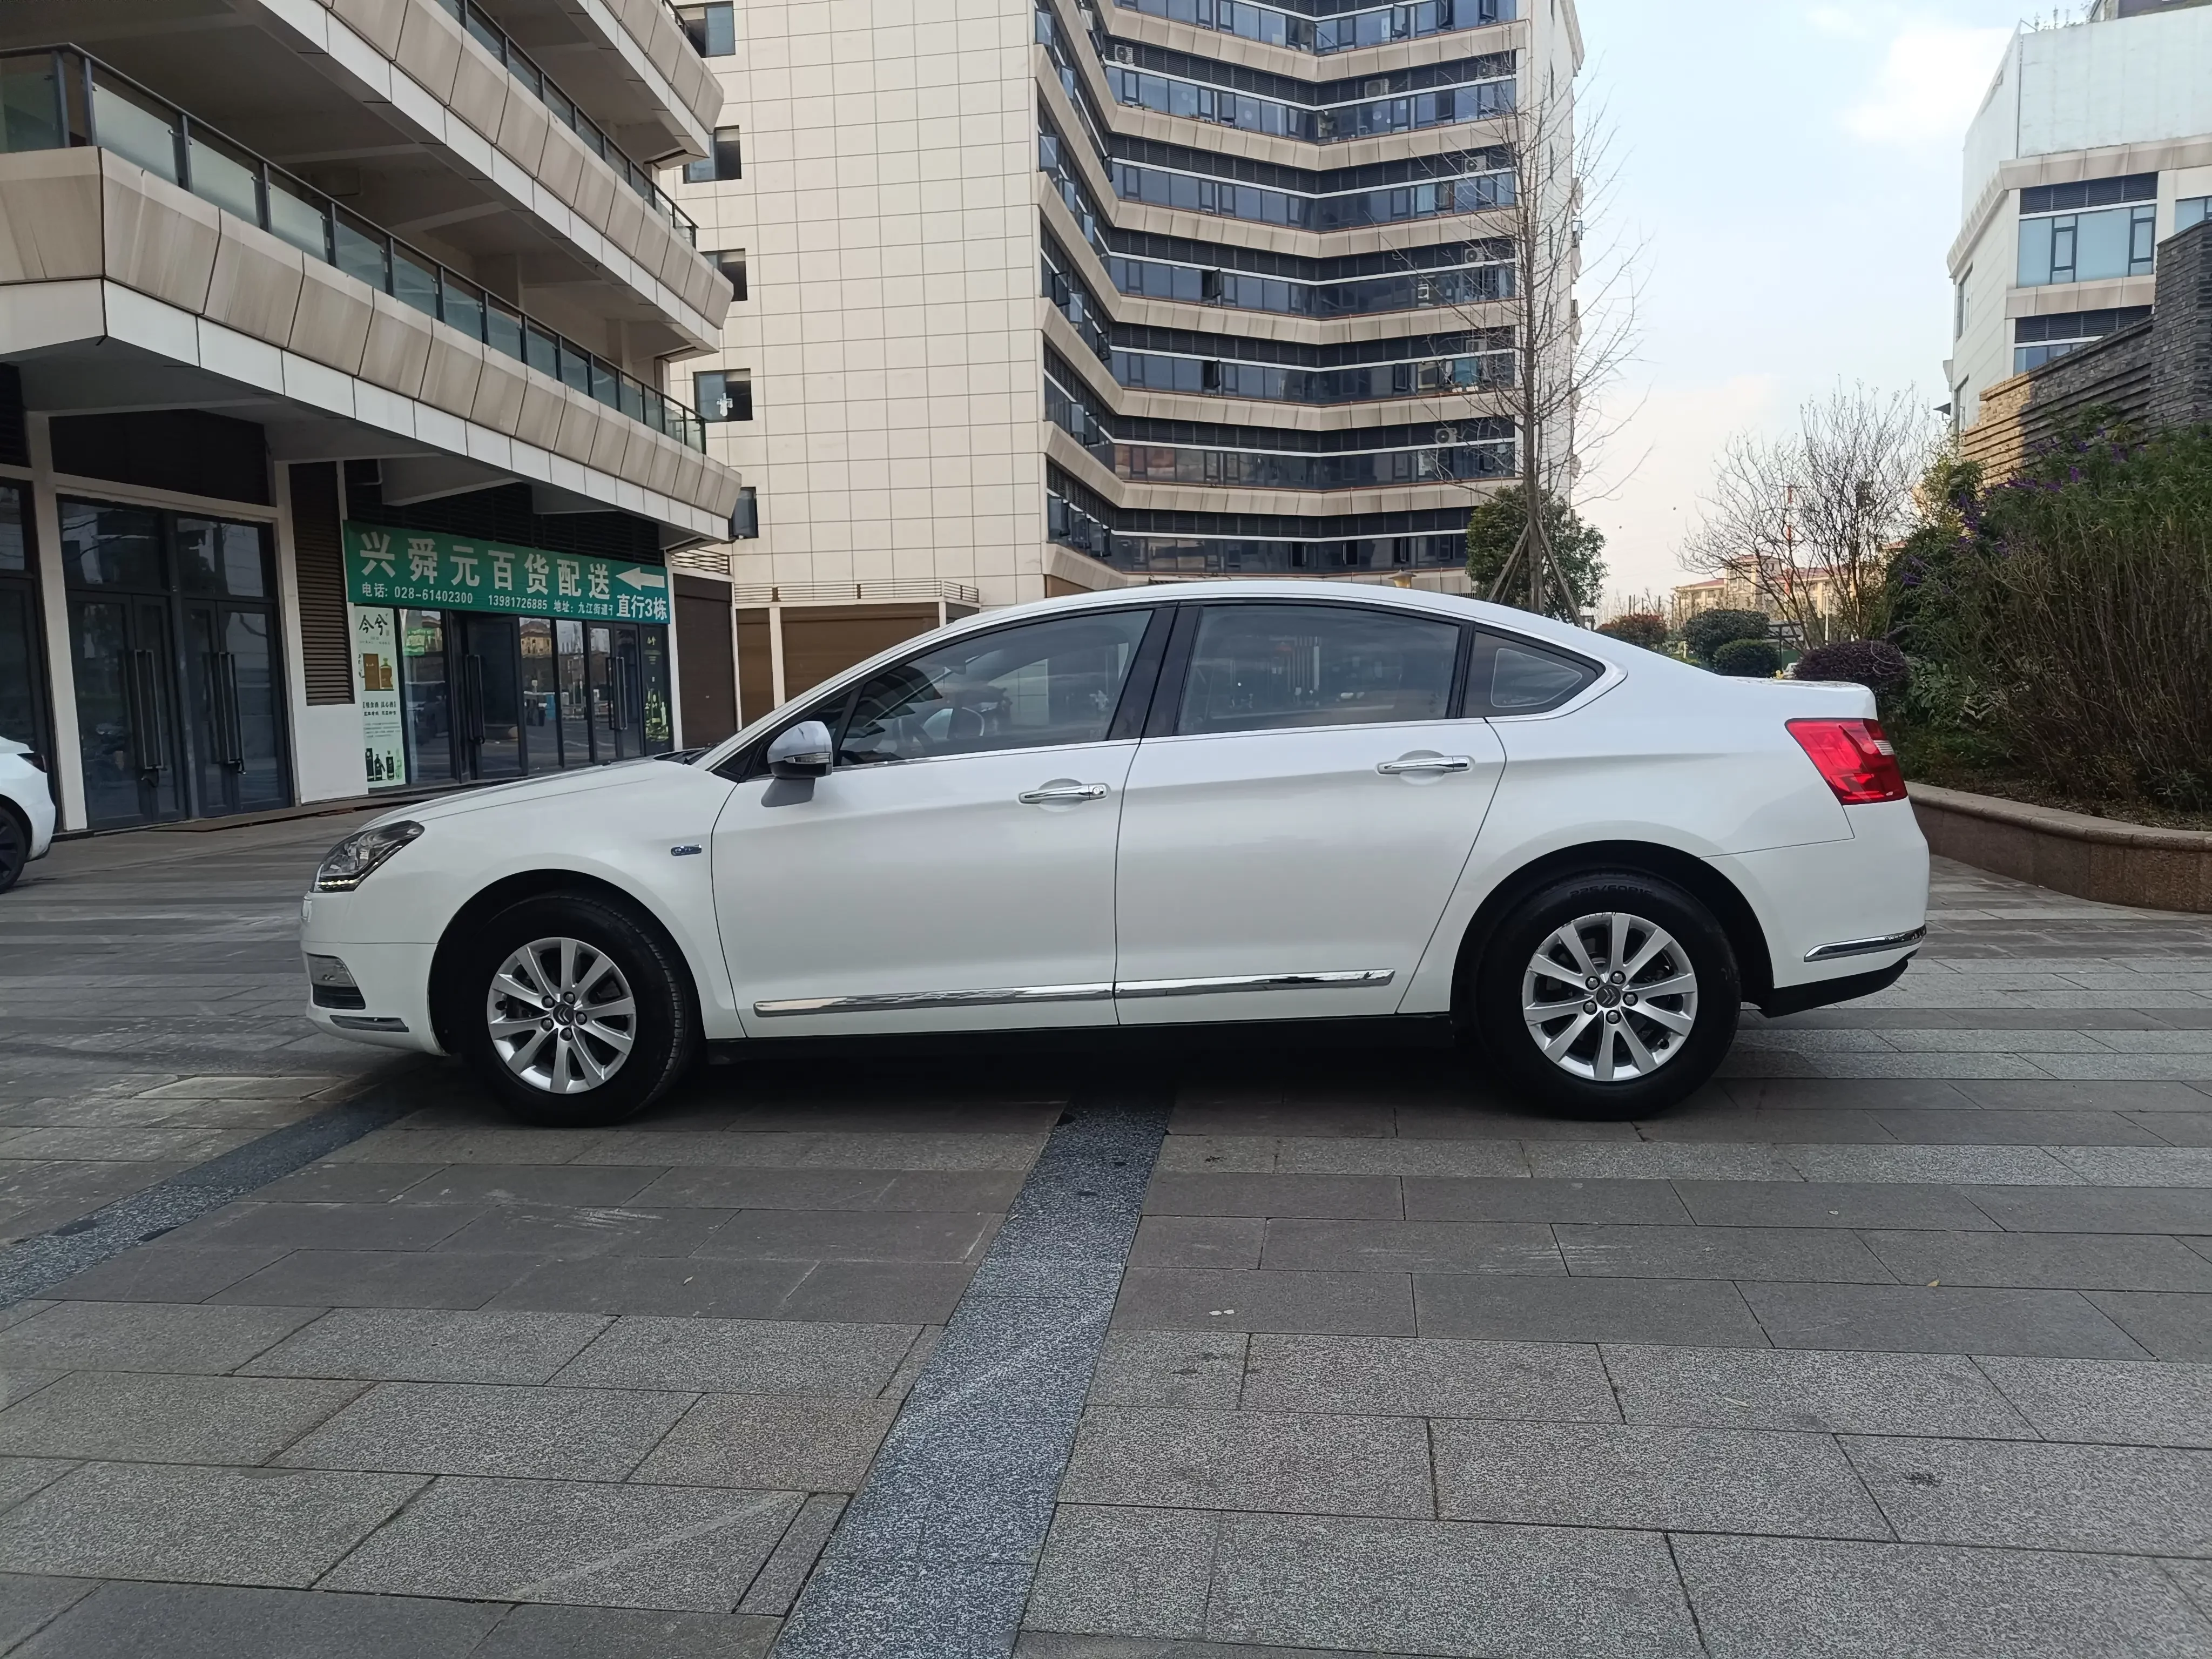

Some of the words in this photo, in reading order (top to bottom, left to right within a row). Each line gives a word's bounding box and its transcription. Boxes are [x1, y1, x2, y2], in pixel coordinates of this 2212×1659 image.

[360, 531, 610, 599] 兴舜元百货配送
[394, 586, 473, 604] 028-61402300
[488, 595, 548, 610] 13981726885
[616, 594, 667, 621] 直行3栋
